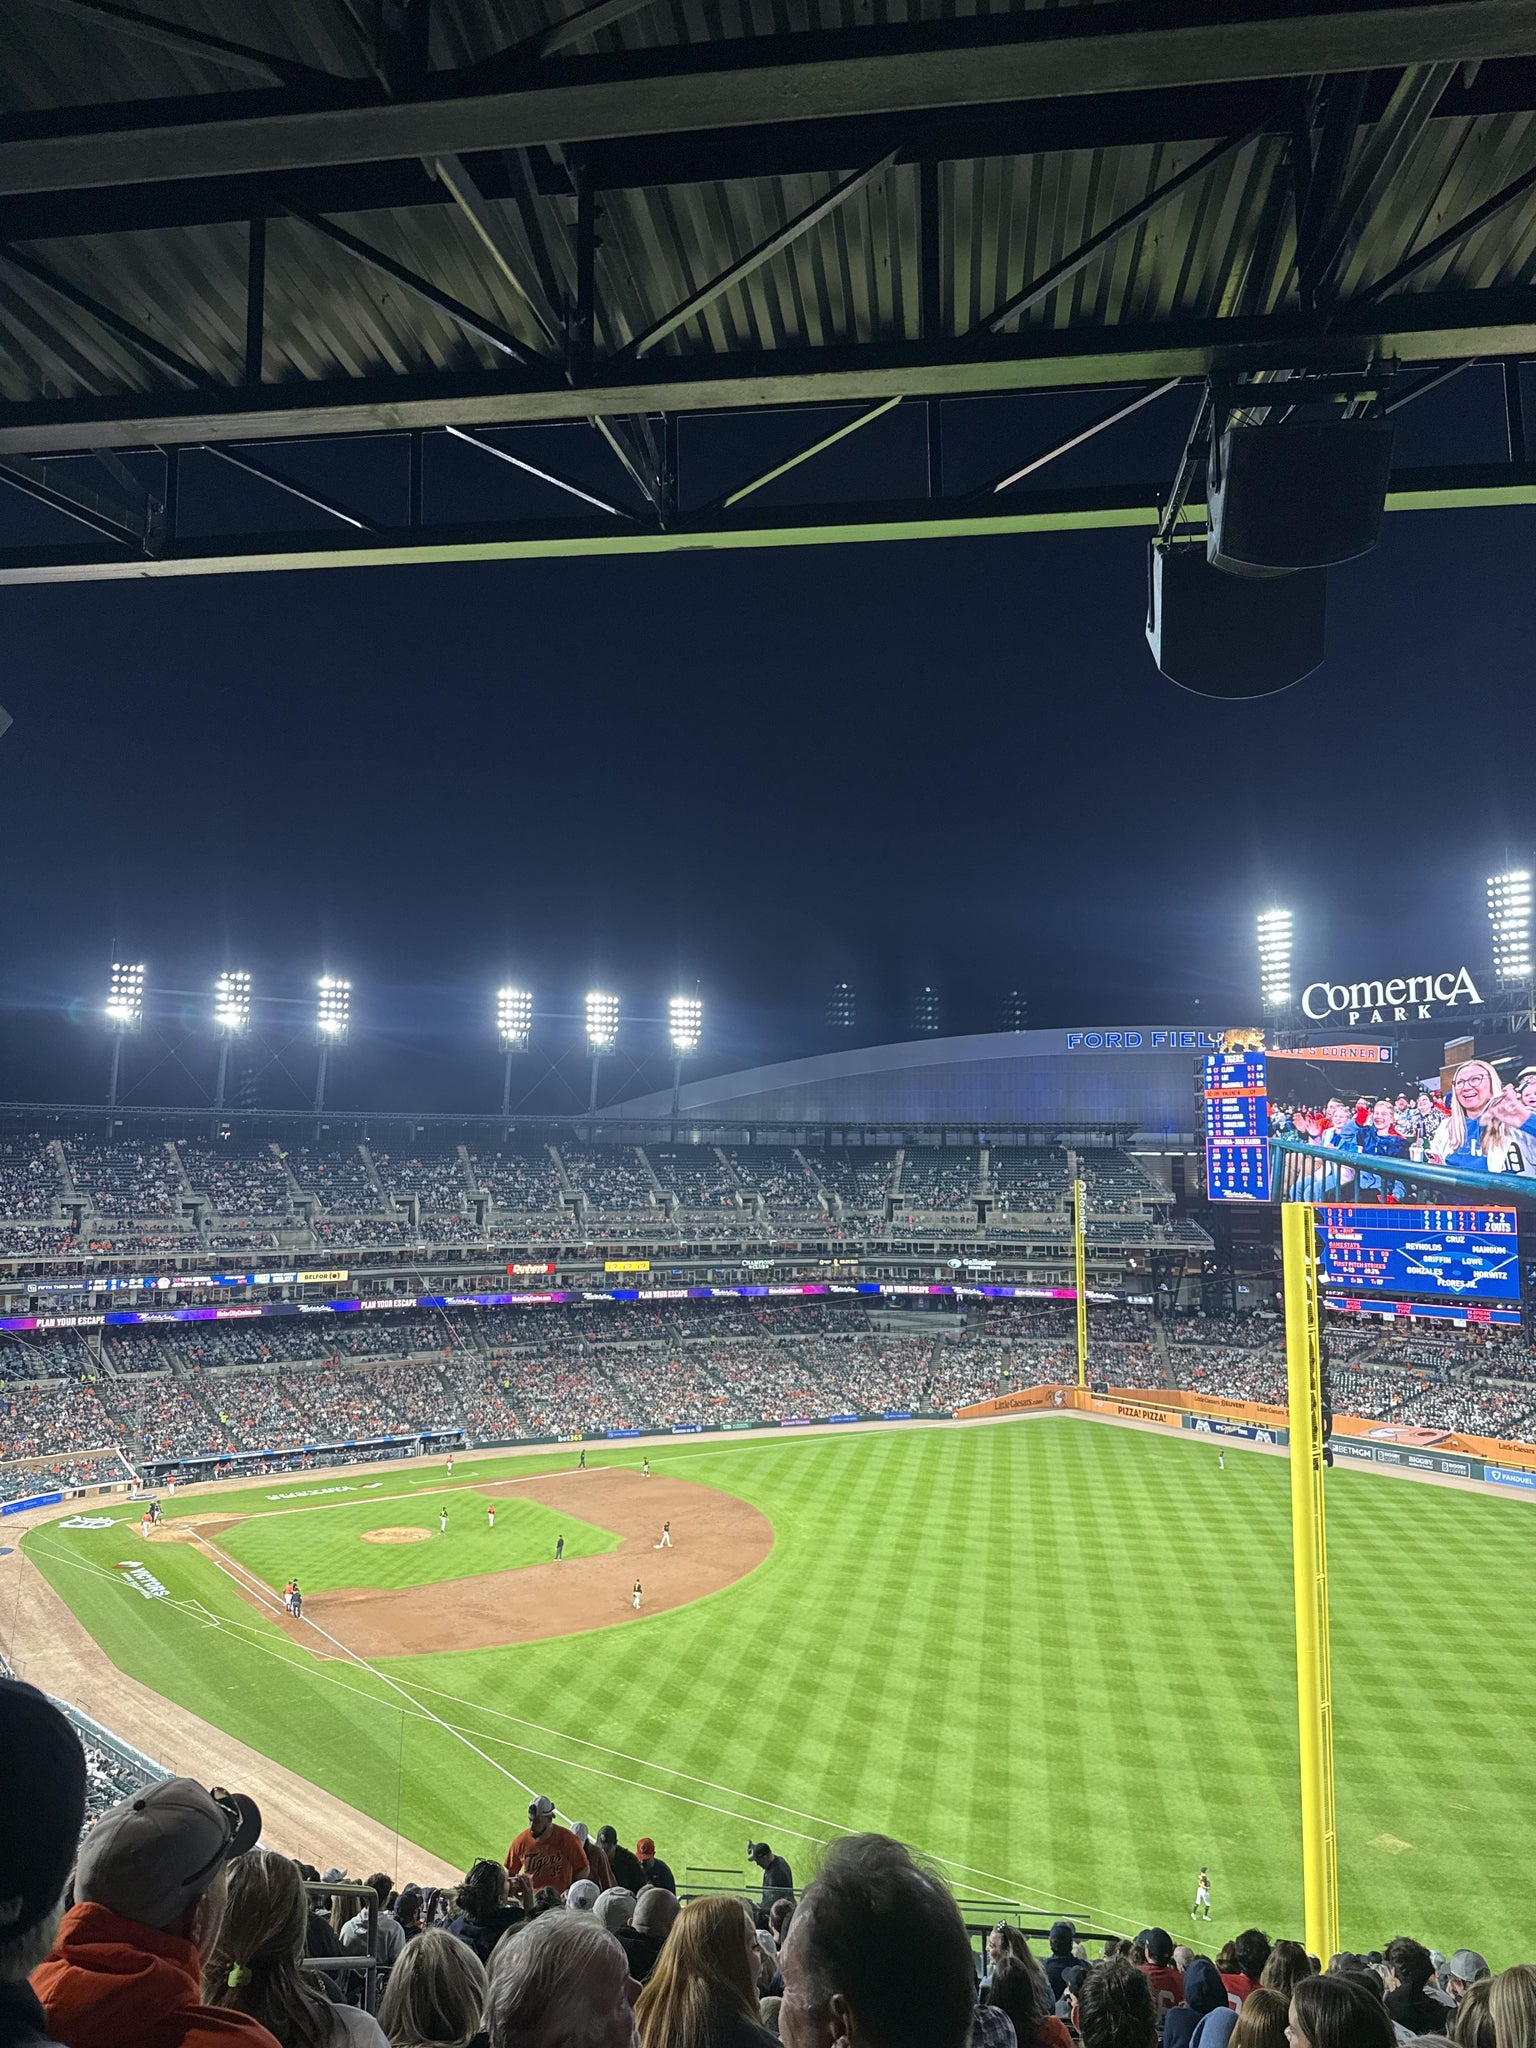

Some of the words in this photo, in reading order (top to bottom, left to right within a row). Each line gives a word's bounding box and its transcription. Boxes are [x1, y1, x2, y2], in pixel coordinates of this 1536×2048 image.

[1349, 1005, 1431, 1026] PARK
[1067, 1032, 1142, 1049] FORD
[1322, 1047, 1375, 1058] CORNER
[1224, 1055, 1244, 1063] TIGERS
[1327, 1208, 1332, 1216] 0
[1338, 1209, 1342, 1217] 2
[1348, 1209, 1352, 1217] 0
[1424, 1211, 1429, 1219] 2
[1435, 1211, 1441, 1219] 2
[1459, 1212, 1464, 1220] 2
[1470, 1212, 1475, 1220] 3
[1328, 1218, 1332, 1226] 0
[1339, 1218, 1343, 1226] 2
[1424, 1221, 1430, 1230] 2
[1436, 1221, 1441, 1230] 2
[1459, 1222, 1464, 1231] 2
[1471, 1222, 1476, 1231] 4
[1485, 1223, 1490, 1232] 2
[1491, 1223, 1511, 1232] OUTS
[1405, 1243, 1442, 1251] REYNOLDS
[1472, 1246, 1506, 1254] MANGUM
[741, 1259, 775, 1267] CHAMPIONS
[963, 1258, 997, 1267] Gallagher
[1423, 1256, 1451, 1264] GRIFFIN
[1406, 1267, 1443, 1275] GONZALES
[1473, 1271, 1507, 1279] HORWITZ
[638, 1291, 652, 1299] PLAN
[668, 1290, 688, 1298] ESCAPE
[909, 1286, 929, 1294] ESCAPE
[361, 1301, 376, 1309] PLAN
[377, 1300, 393, 1308] YOUR
[394, 1299, 416, 1307] ESCAPE
[36, 1317, 56, 1327] PLAN
[57, 1316, 76, 1326] YOUR
[78, 1315, 105, 1325] ESCAPE
[1410, 1338, 1457, 1346] CHEVROLET
[1221, 1400, 1245, 1409] DELIVERY
[1118, 1405, 1142, 1418] PIZZA!
[1142, 1410, 1167, 1422] PIZZA!
[1268, 1407, 1285, 1415] Caesars
[558, 1434, 583, 1442] bet365
[1339, 1445, 1371, 1458] BETMGM
[1499, 1443, 1513, 1451] Little
[1513, 1445, 1535, 1454] Caesars
[1408, 1455, 1433, 1466] BIGGBY
[1449, 1468, 1467, 1476] COFFEE
[1502, 1474, 1534, 1485] FANDUEL
[130, 1567, 171, 1597] VICTORS
[525, 1852, 562, 1875] Tigers
